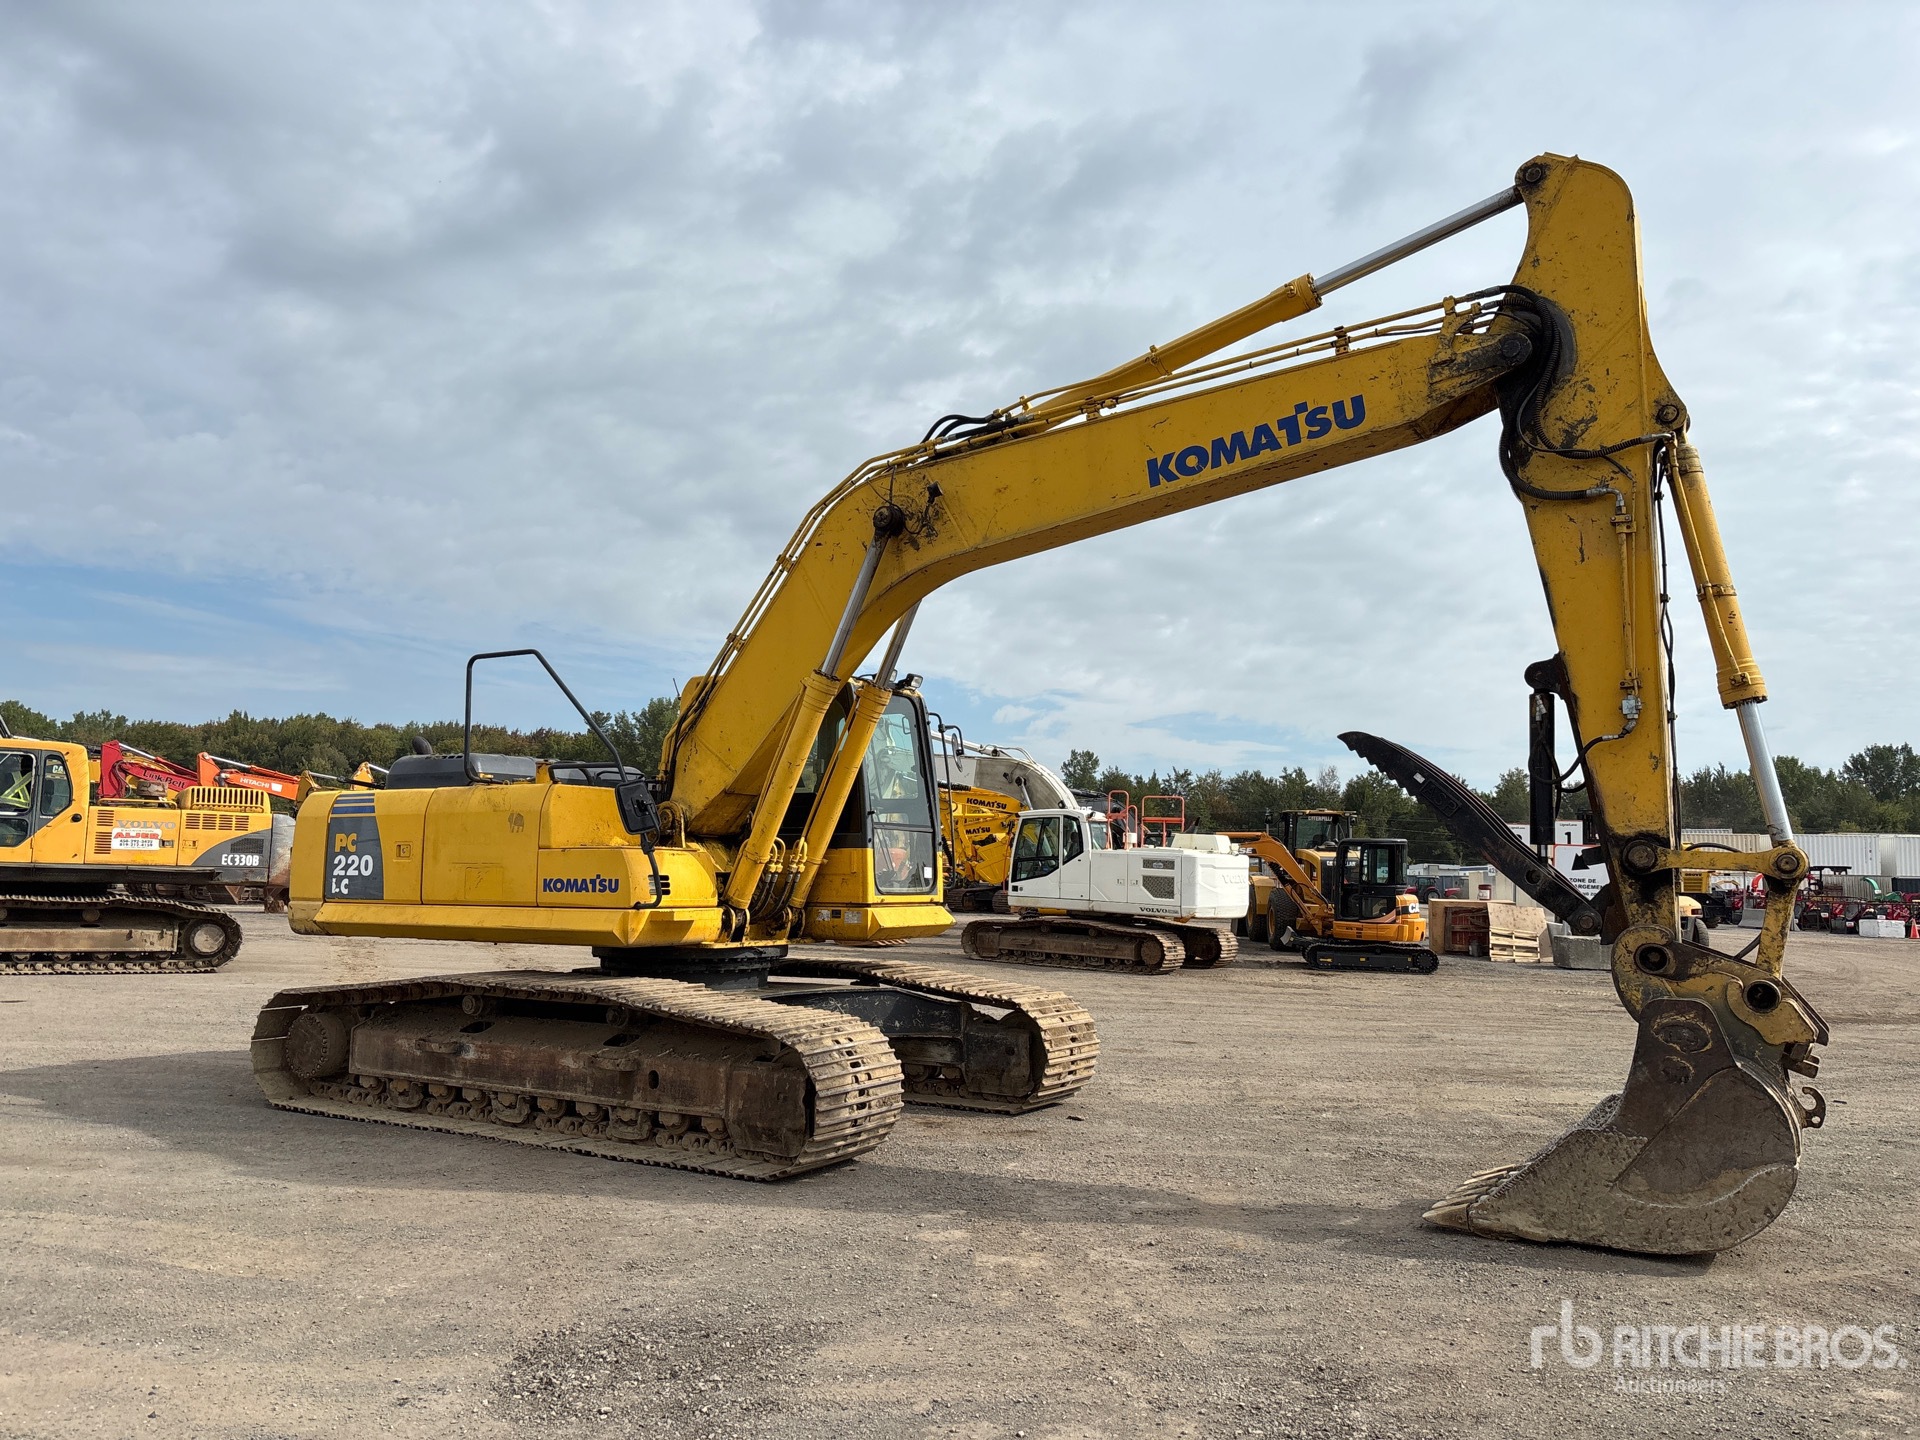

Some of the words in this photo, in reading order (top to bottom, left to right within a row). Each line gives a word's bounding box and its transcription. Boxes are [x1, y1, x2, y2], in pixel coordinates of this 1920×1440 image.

[1146, 394, 1366, 488] KOMATSU
[52, 765, 66, 774] CA
[240, 777, 270, 788] HITACHI
[966, 798, 1007, 810] KOMATSU
[116, 820, 176, 829] VOLVO
[966, 826, 991, 835] MATSU
[335, 833, 357, 852] PC
[1564, 831, 1572, 844] 1
[221, 854, 260, 866] EC330B
[333, 855, 374, 876] 220
[543, 874, 620, 893] KOMATSU
